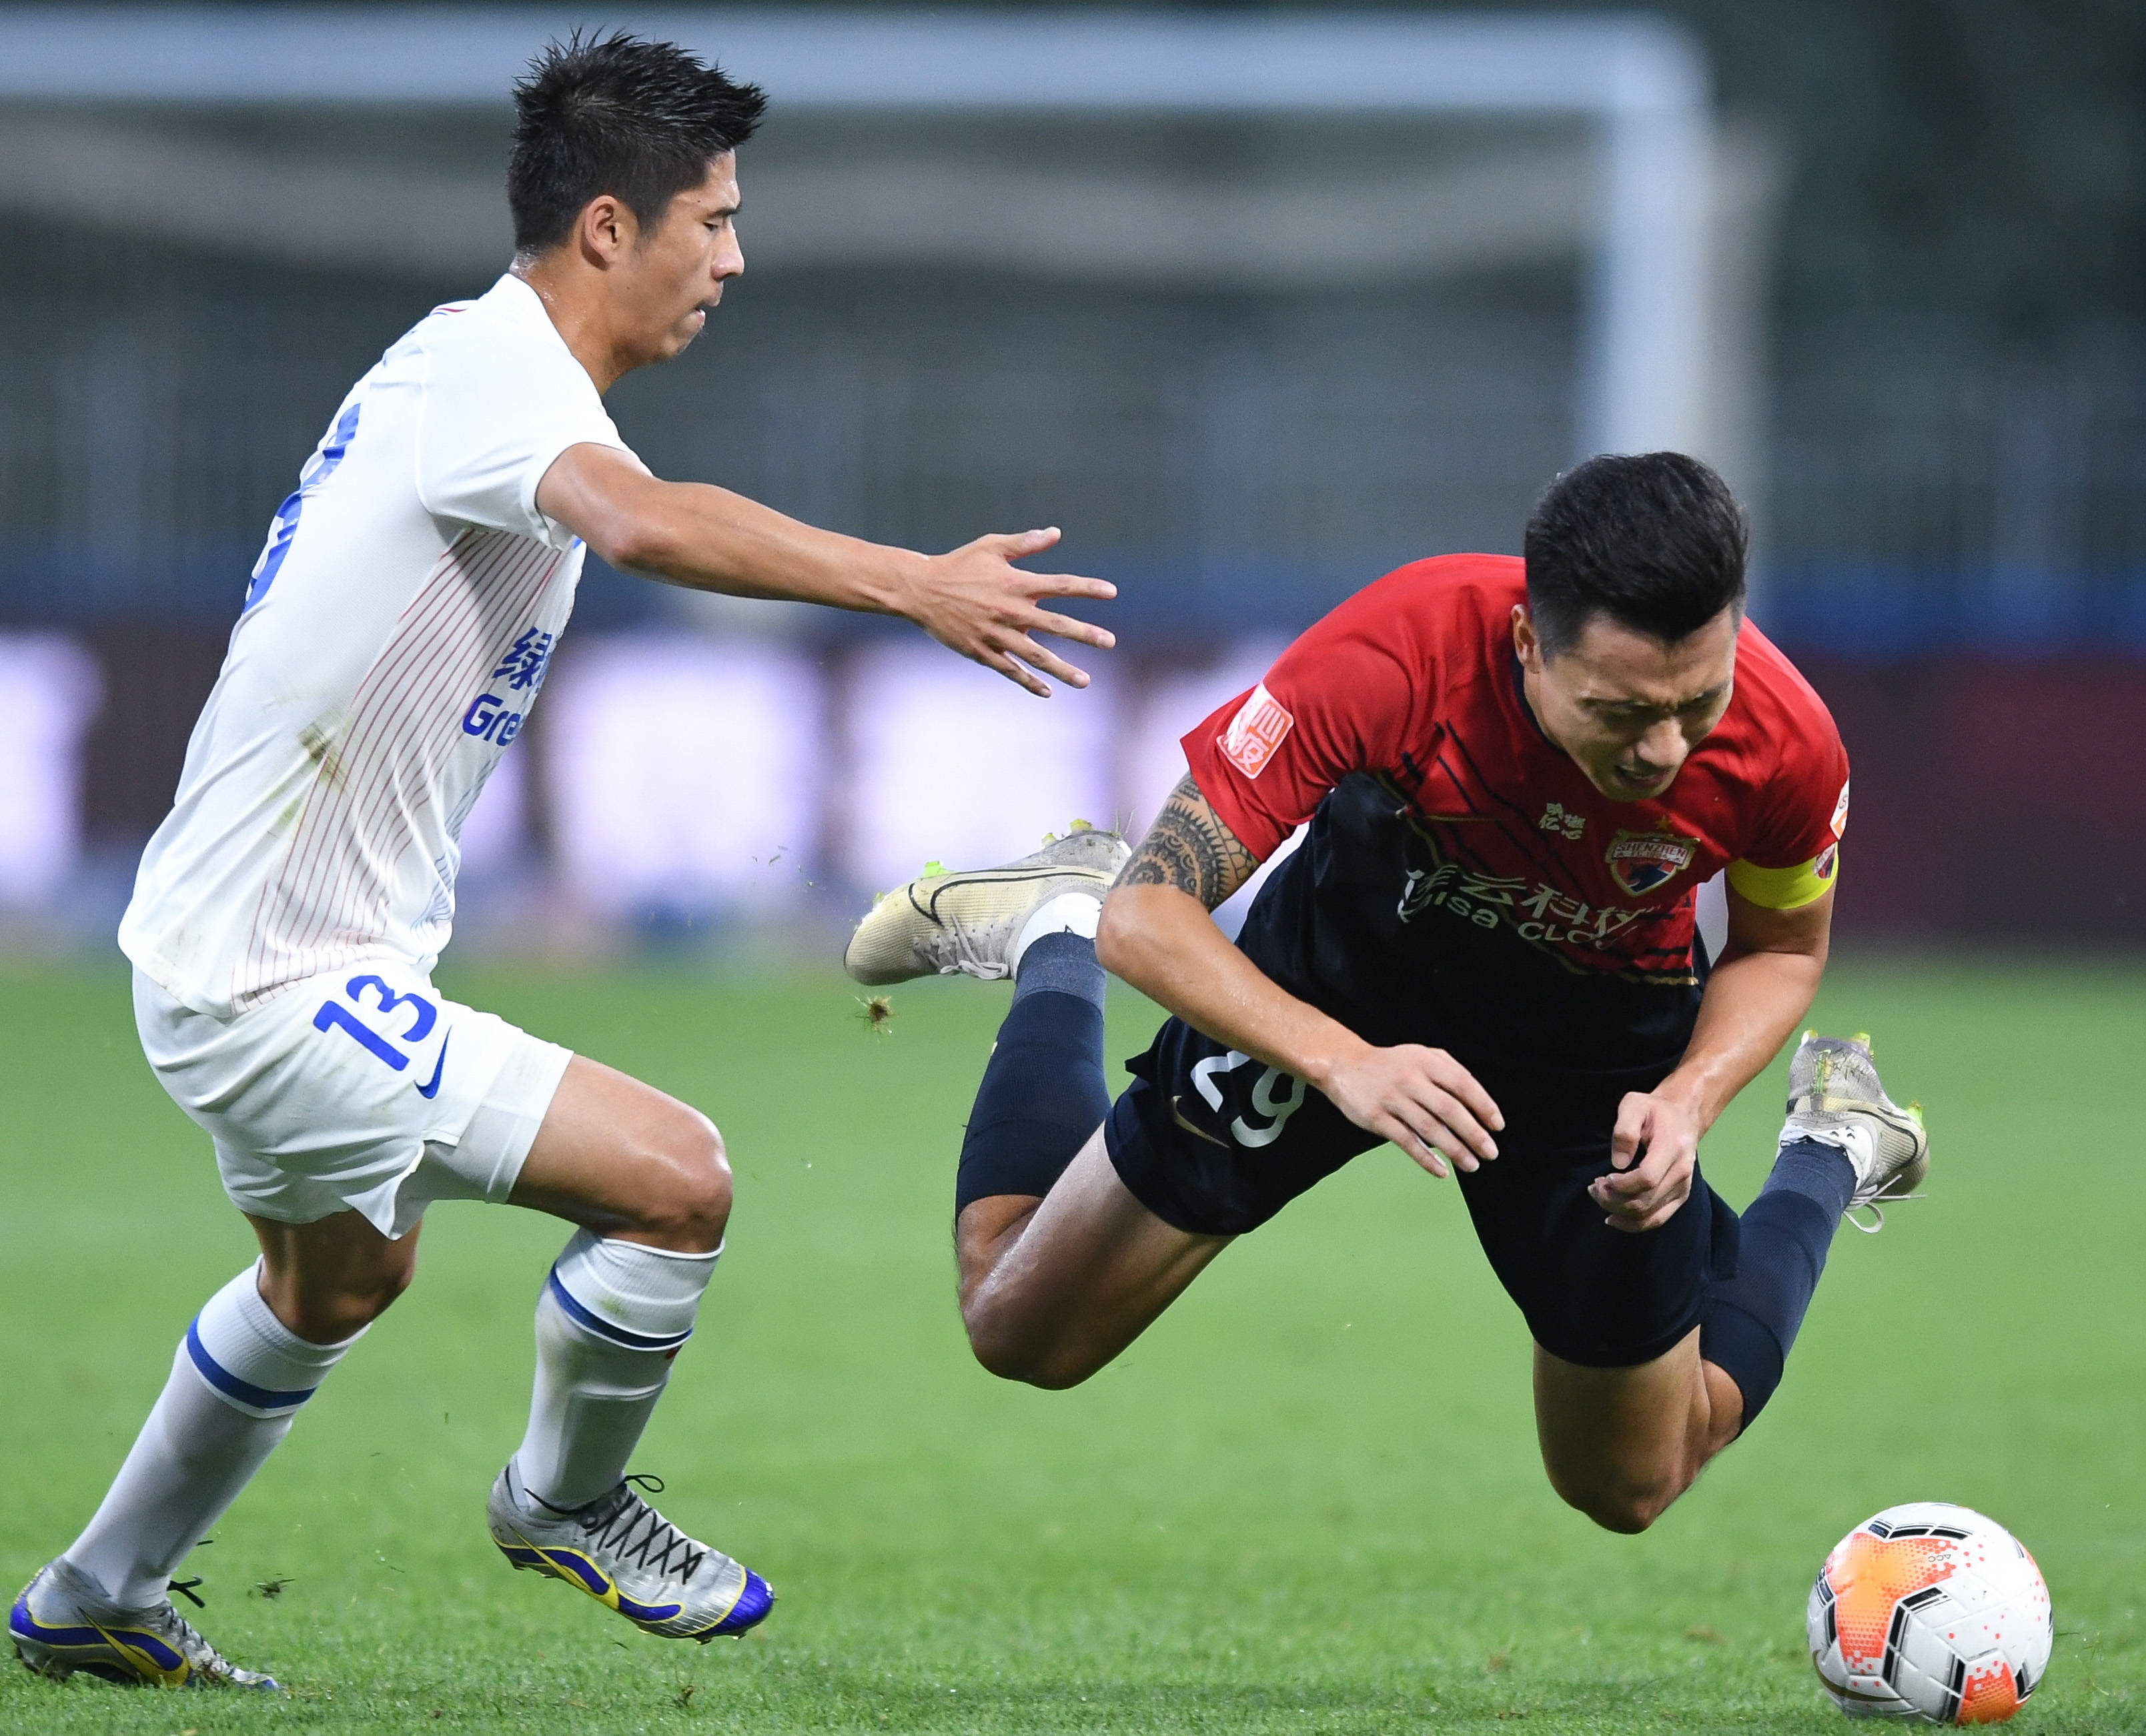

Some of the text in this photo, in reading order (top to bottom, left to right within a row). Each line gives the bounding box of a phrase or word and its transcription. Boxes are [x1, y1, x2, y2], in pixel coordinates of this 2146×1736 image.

[492, 626, 552, 691] 绿
[462, 693, 524, 747] Gre
[1618, 843, 1687, 858] SHENZHEN
[313, 974, 438, 1072] 13
[1190, 1050, 1307, 1148] 29
